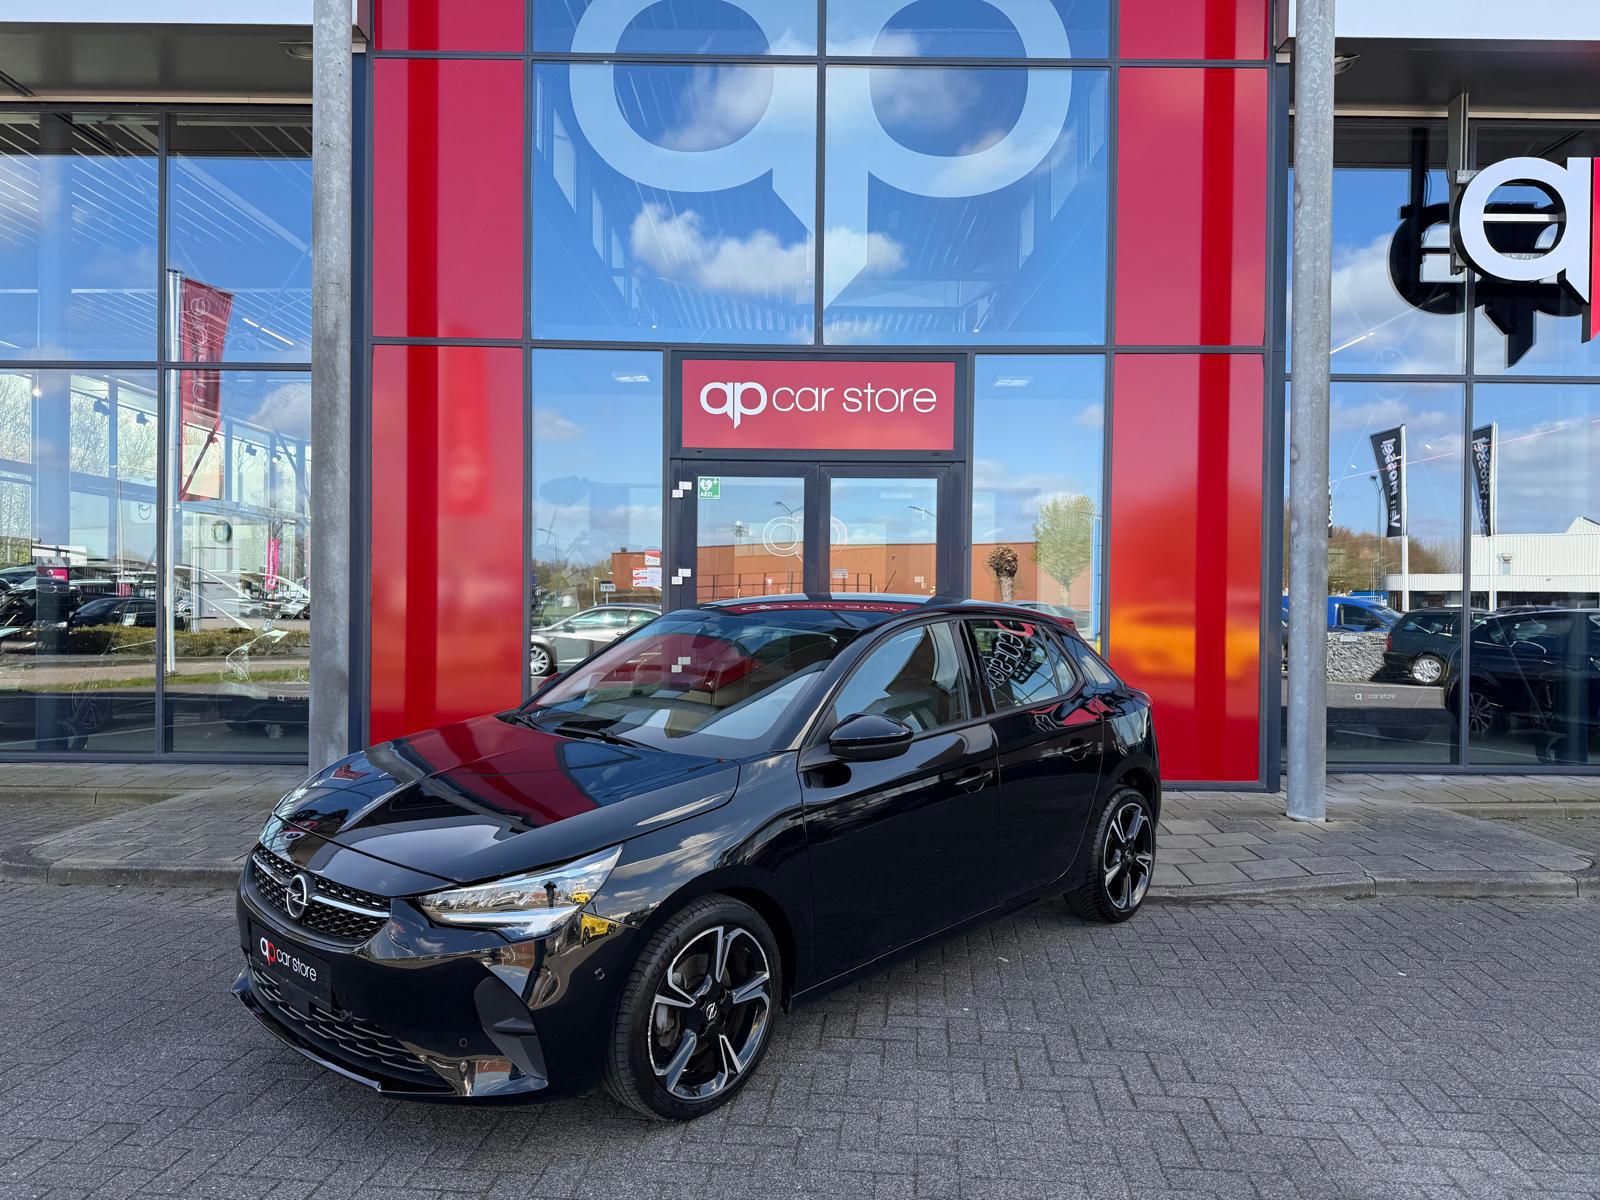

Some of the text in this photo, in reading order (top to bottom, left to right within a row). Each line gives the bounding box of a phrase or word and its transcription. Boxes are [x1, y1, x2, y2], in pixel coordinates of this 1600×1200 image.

[700, 382, 938, 429] ap car store
[276, 948, 292, 968] car
[292, 957, 318, 982] store
